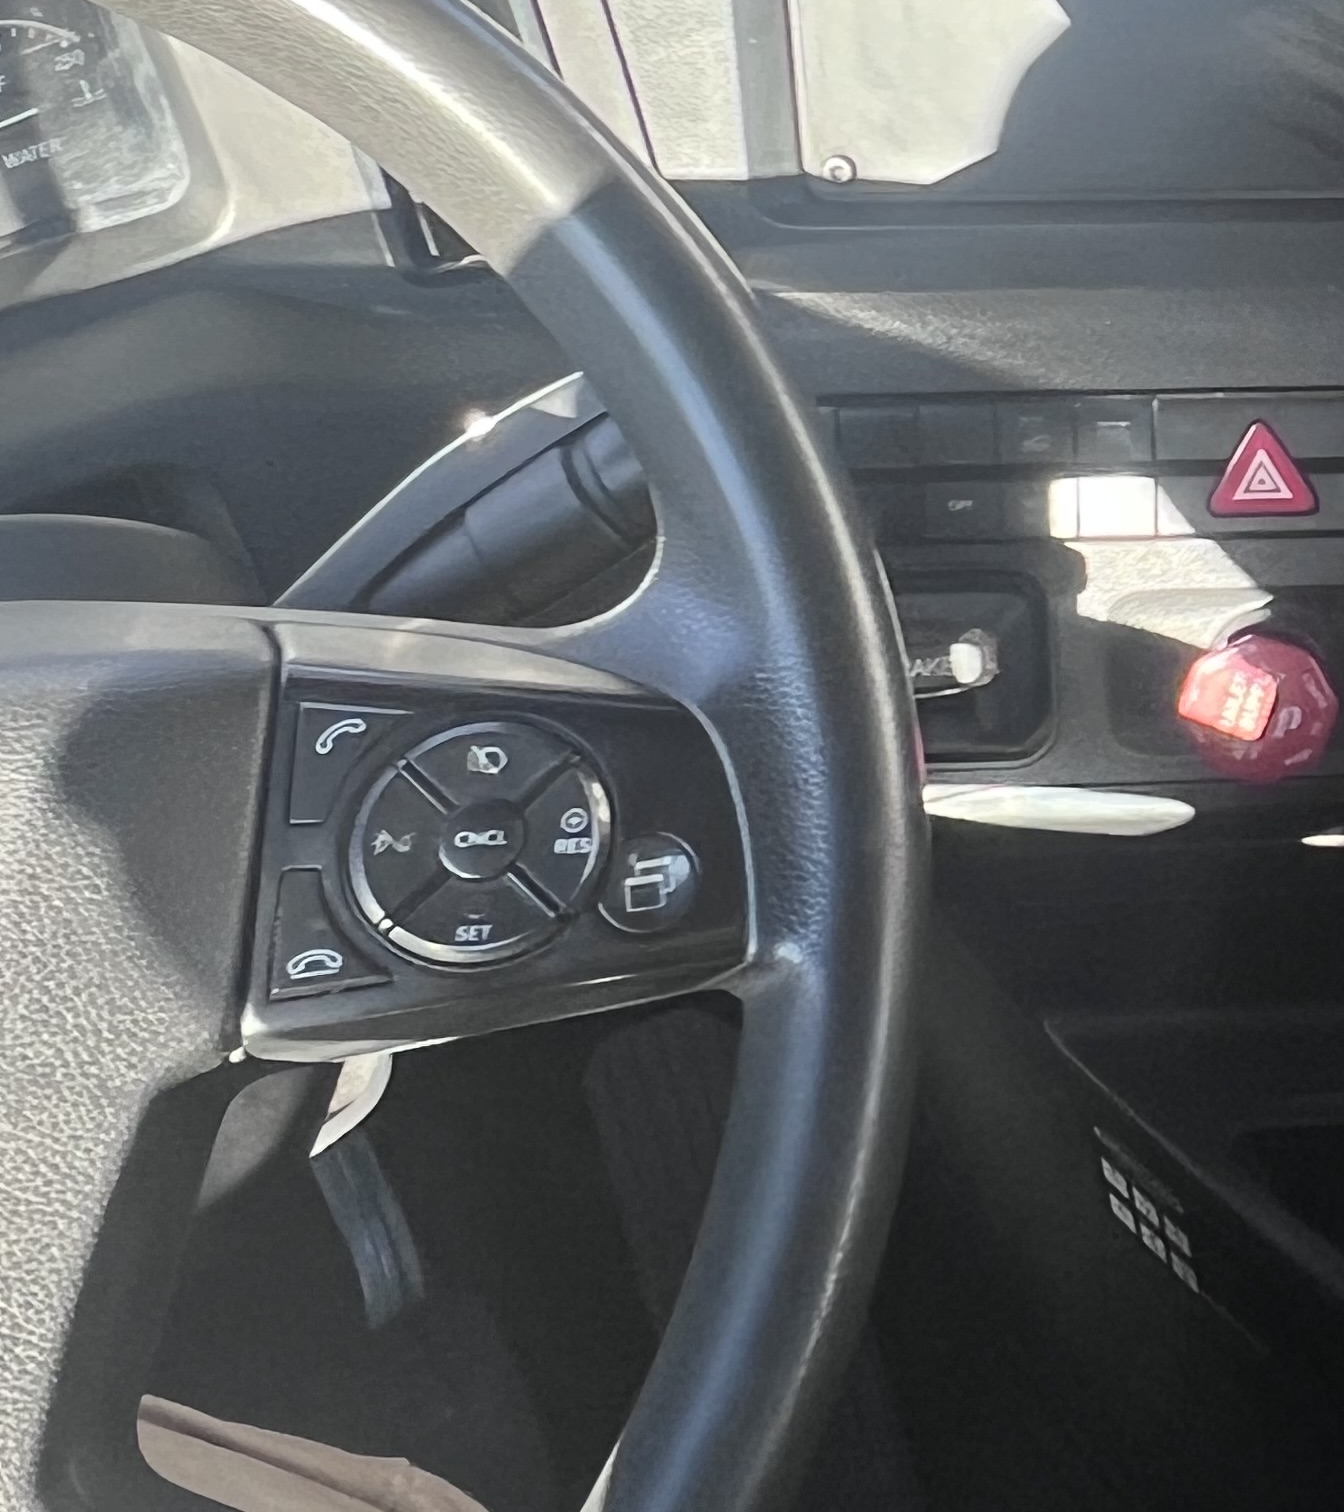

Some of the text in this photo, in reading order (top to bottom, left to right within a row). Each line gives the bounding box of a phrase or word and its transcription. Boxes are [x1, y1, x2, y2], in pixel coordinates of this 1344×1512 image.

[2, 138, 64, 169] WATER
[554, 838, 594, 854] RES
[455, 924, 492, 942] SET
